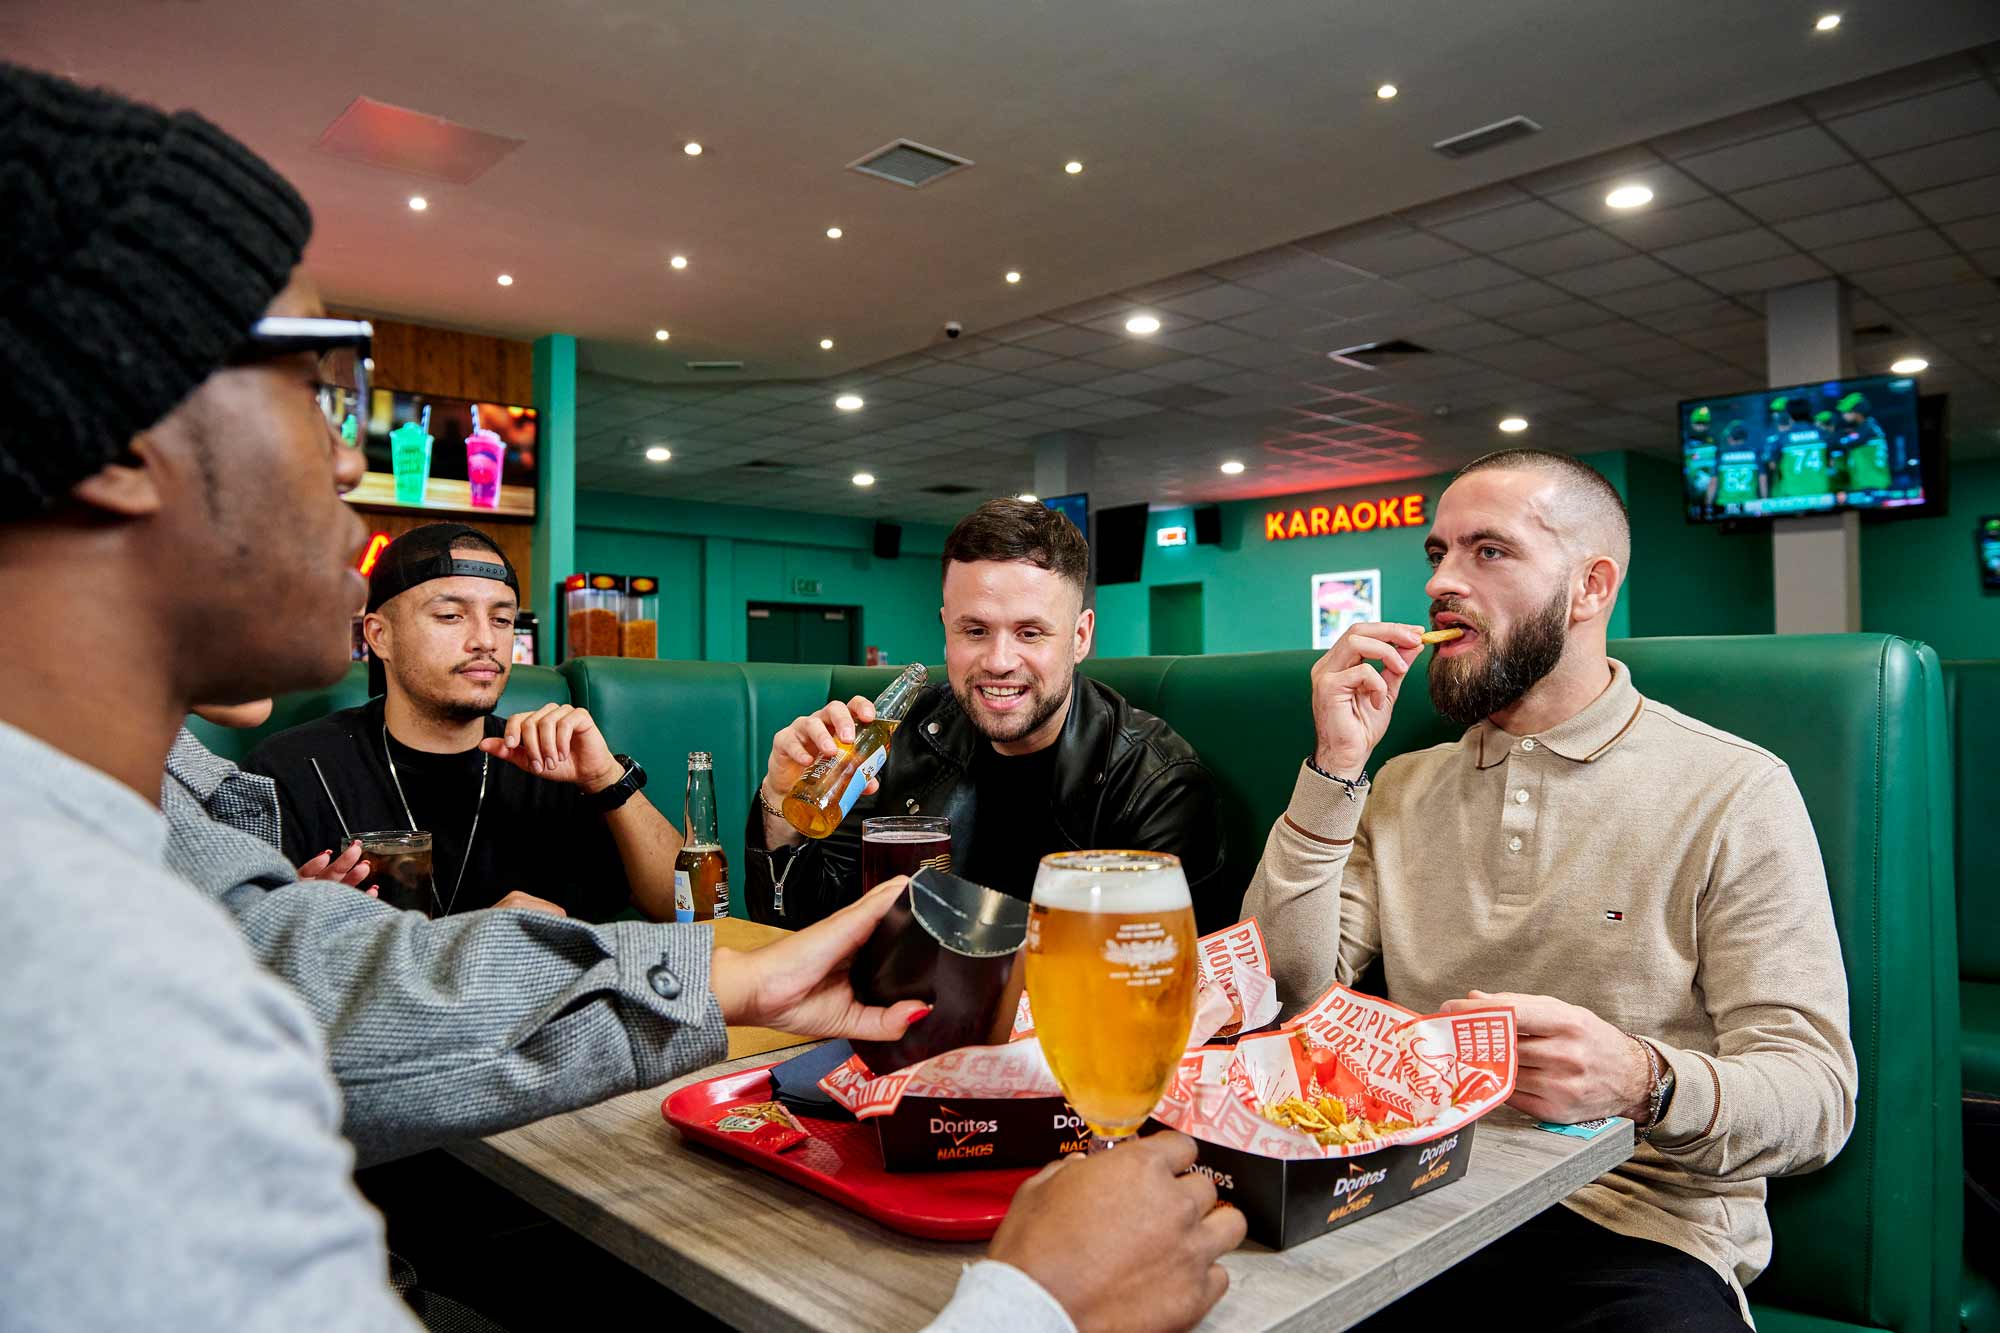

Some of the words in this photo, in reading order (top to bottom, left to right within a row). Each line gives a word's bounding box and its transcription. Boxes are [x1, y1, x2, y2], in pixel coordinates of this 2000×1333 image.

[1265, 494, 1425, 541] KARAOKE
[930, 1117, 998, 1134] Doritos
[937, 1143, 994, 1161] NACHOS
[1059, 1138, 1092, 1154] NAC
[1418, 1134, 1459, 1166] Doritos
[1333, 1167, 1388, 1198] Doritos
[1409, 1161, 1451, 1191] NACHOS
[1326, 1193, 1375, 1225] NACHOS
